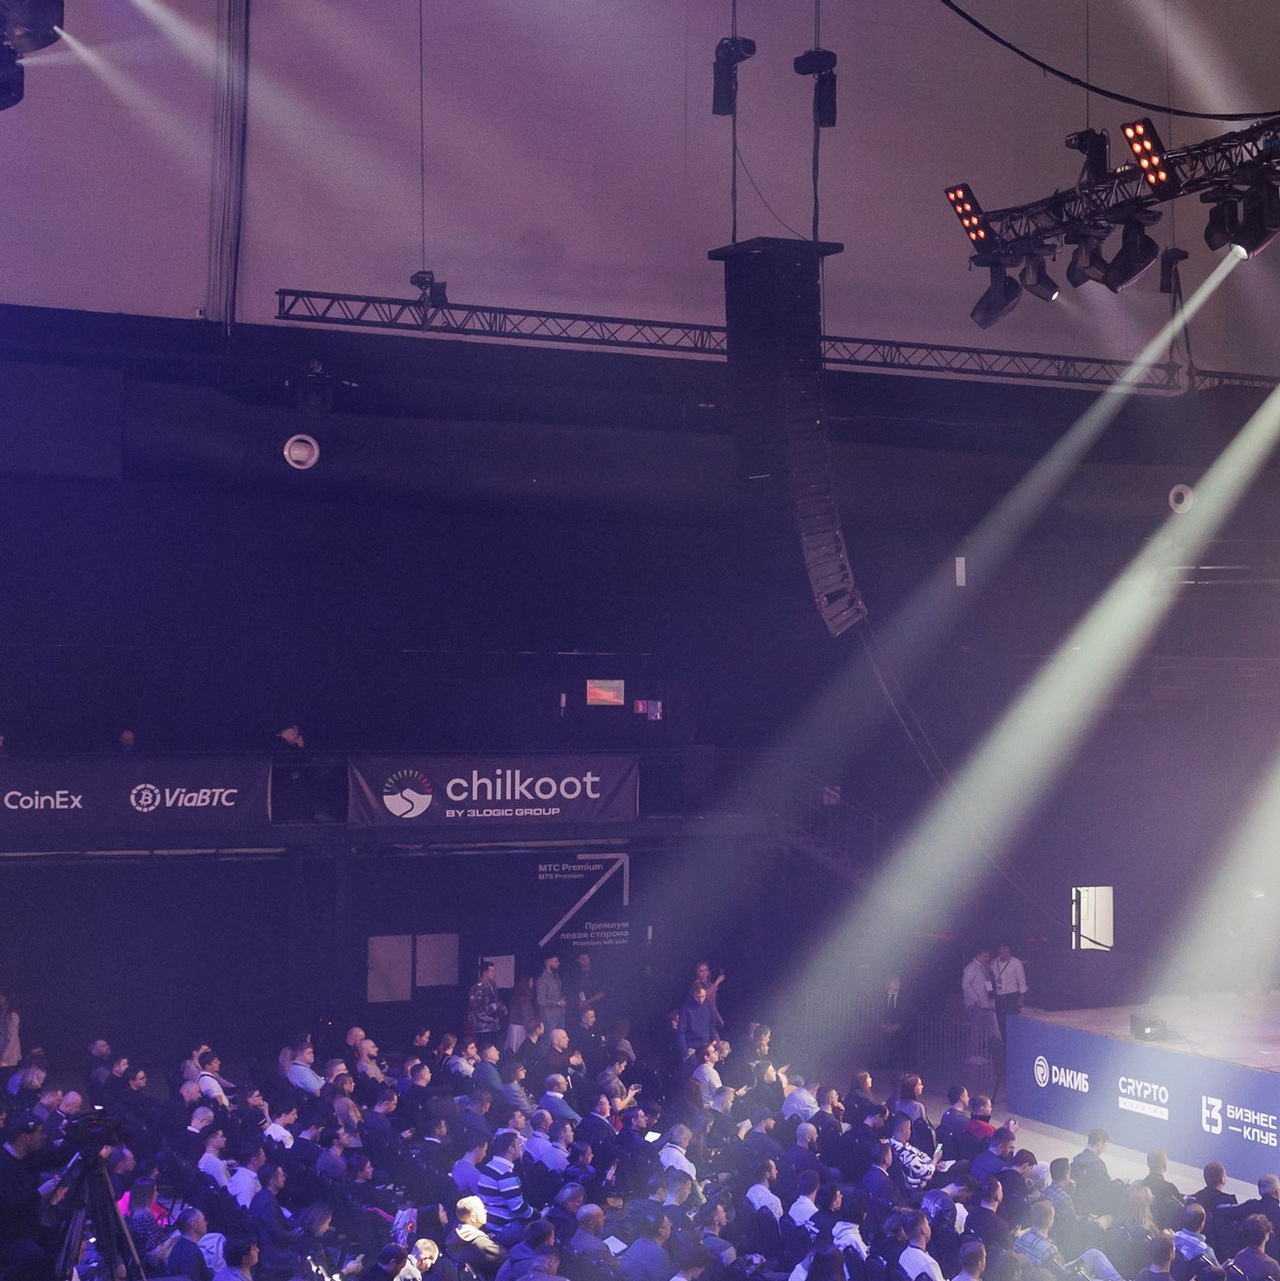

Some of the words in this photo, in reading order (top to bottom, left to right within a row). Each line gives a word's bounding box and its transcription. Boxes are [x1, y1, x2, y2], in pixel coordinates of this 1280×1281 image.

[446, 768, 600, 801] chilkoot
[3, 790, 83, 810] CoinEx
[164, 787, 238, 807] ViaBTC
[445, 809, 464, 818] BY
[467, 809, 513, 817] 3LOGIC
[515, 807, 560, 817] GROUP
[562, 862, 604, 871] Premium
[585, 922, 629, 931] Премиум
[1051, 1065, 1089, 1093] РАКИБ
[1118, 1076, 1169, 1104] CRYPTO
[1226, 1104, 1278, 1130] БИЗНЕС
